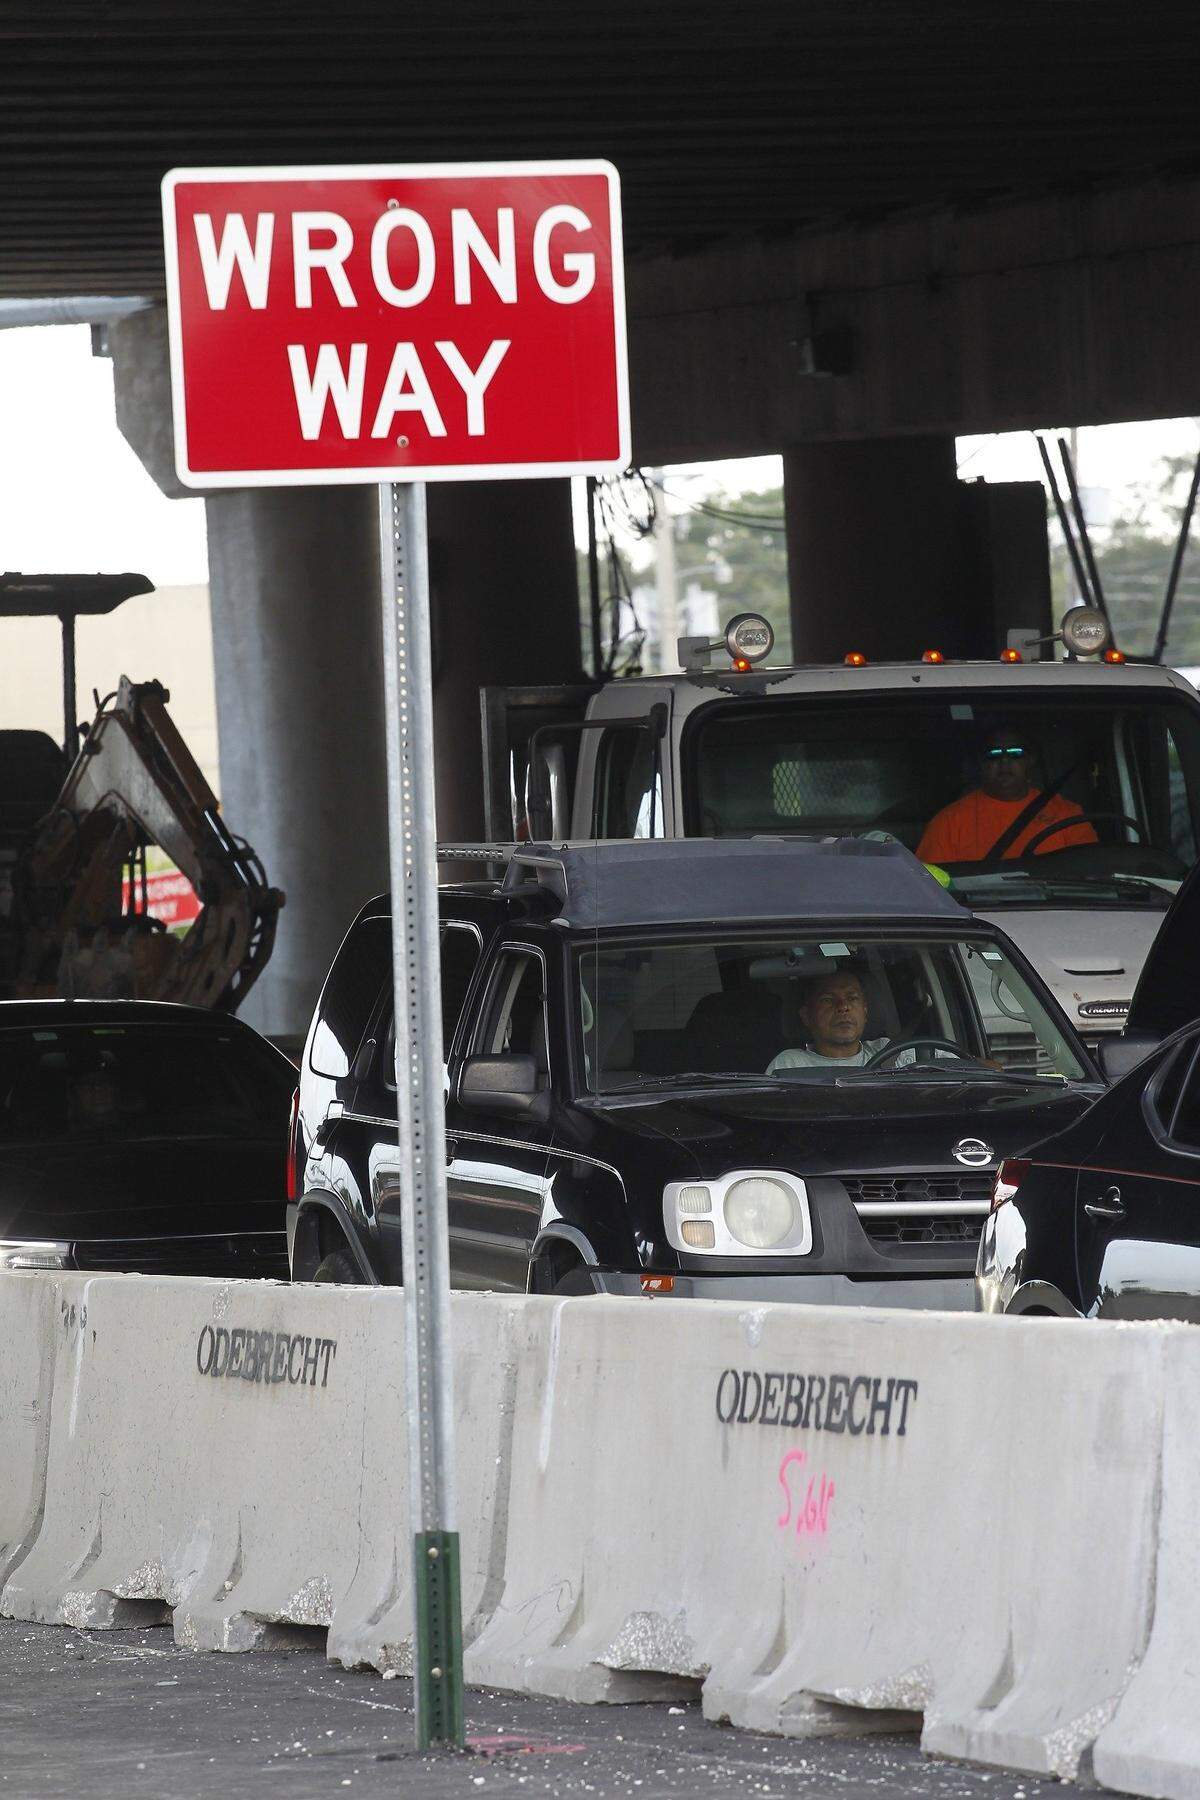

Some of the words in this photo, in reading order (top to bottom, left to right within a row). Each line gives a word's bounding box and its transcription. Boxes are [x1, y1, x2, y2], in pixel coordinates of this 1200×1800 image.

[193, 204, 597, 311] WRONG
[287, 339, 511, 441] WAY
[196, 1325, 338, 1387] ODEBRECHT
[715, 1369, 918, 1436] ODEBRECHT
